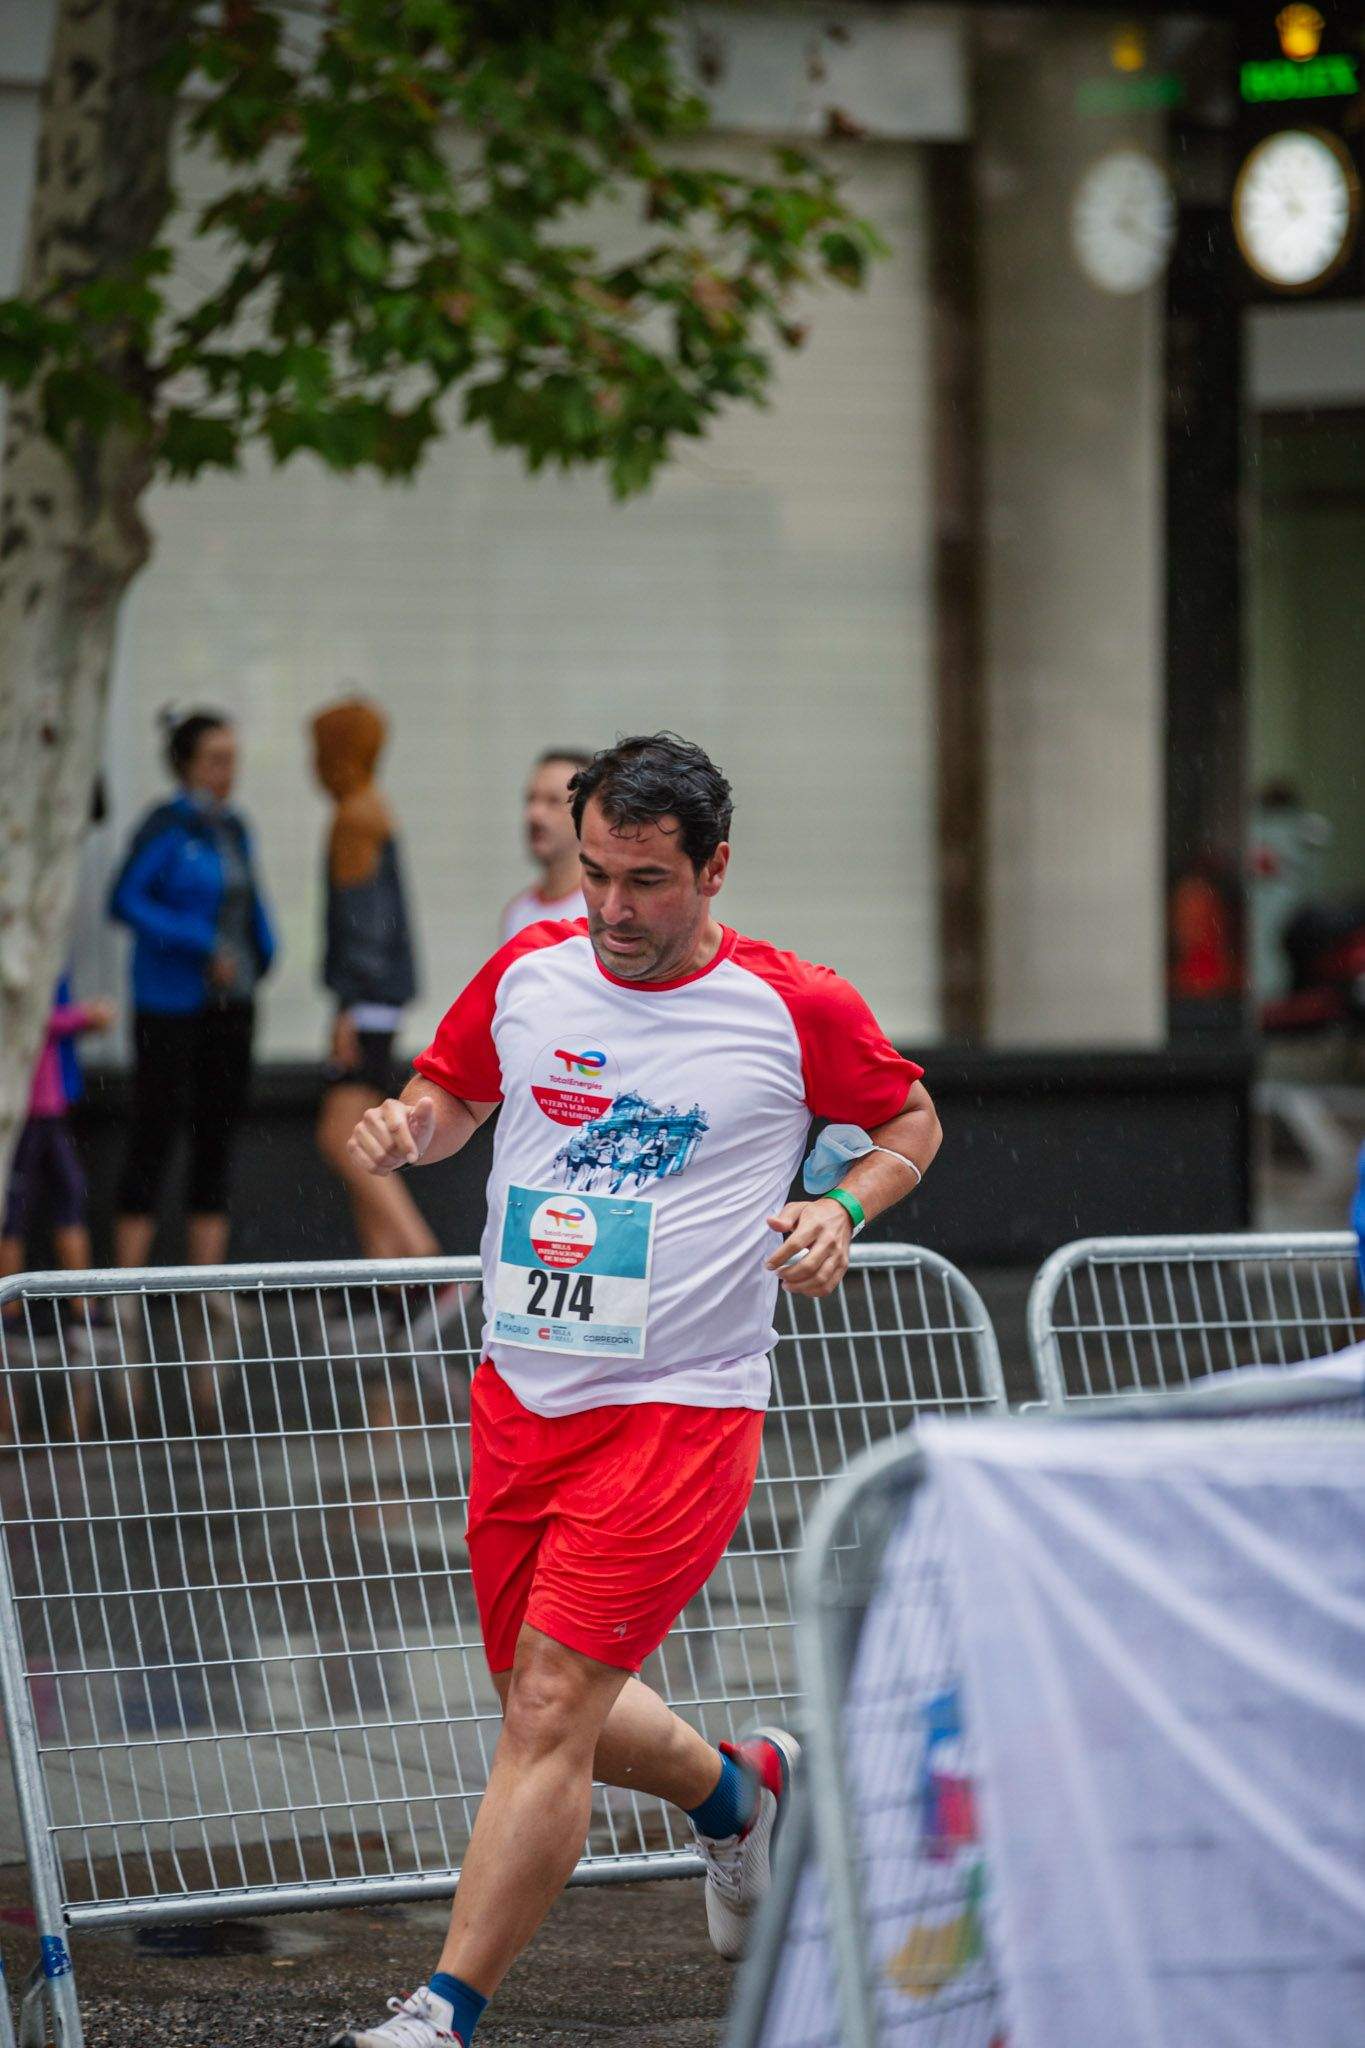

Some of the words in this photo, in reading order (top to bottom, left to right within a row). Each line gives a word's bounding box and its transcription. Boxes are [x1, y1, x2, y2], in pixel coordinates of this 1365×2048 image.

[550, 1075, 603, 1090] TotalEnergies
[559, 1093, 585, 1104] MILLA
[540, 1098, 601, 1114] INTERNACIONAL
[547, 1107, 560, 1116] DE
[526, 1269, 594, 1322] 274
[503, 1324, 530, 1336] MADRID
